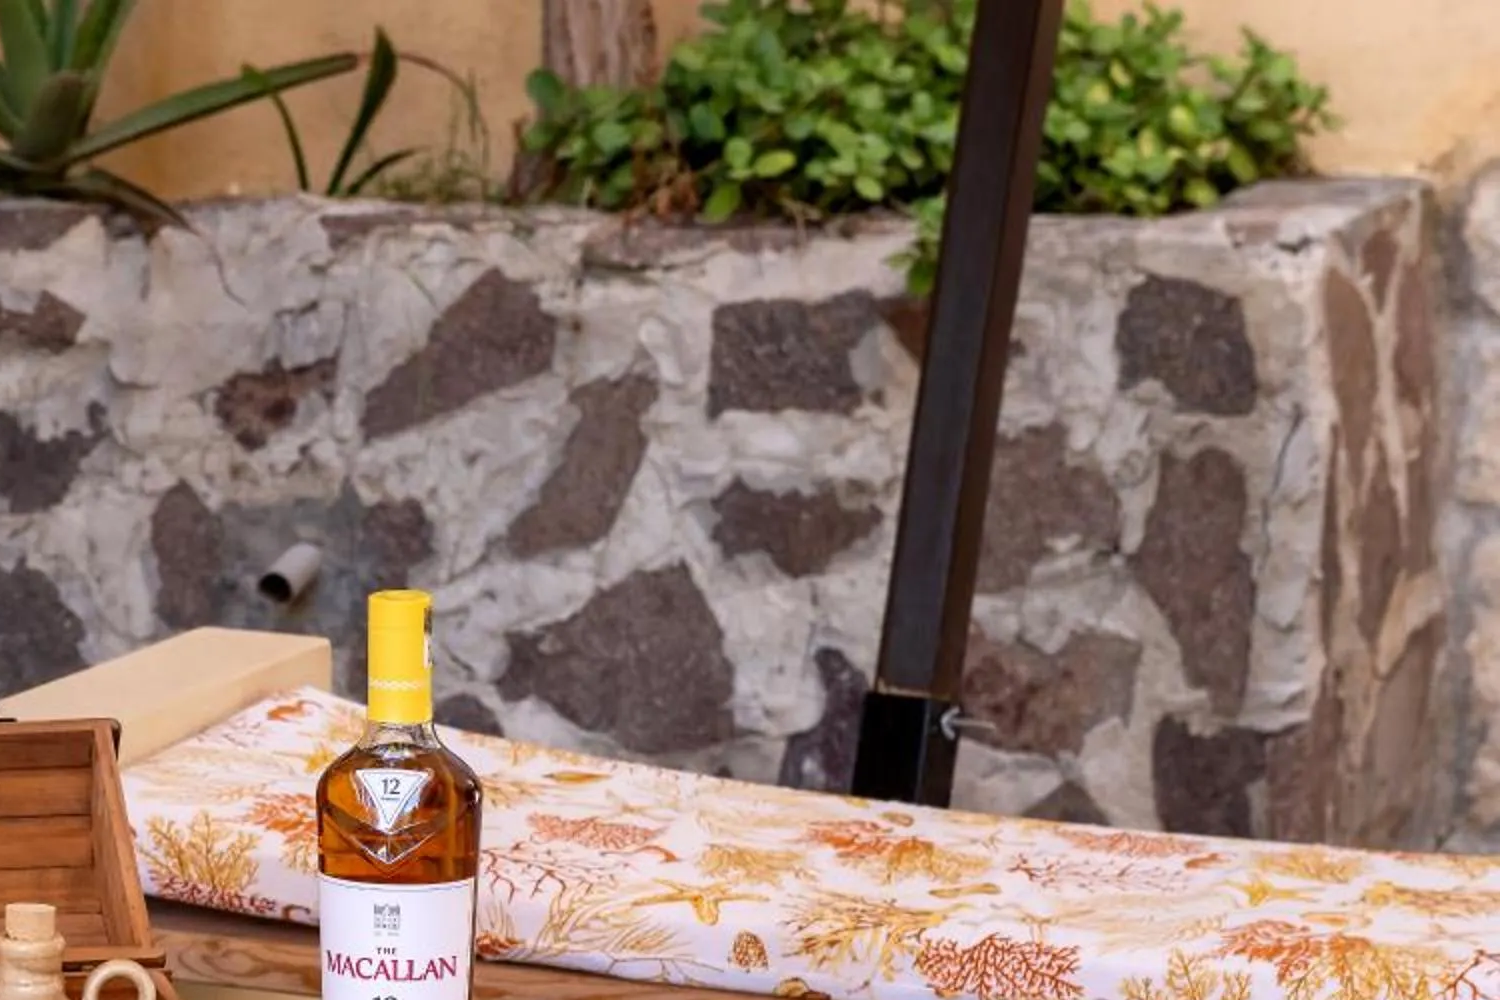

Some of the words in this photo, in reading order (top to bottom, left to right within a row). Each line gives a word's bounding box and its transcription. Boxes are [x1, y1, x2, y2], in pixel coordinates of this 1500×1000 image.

[381, 778, 401, 795] 12
[375, 947, 397, 955] THE
[325, 949, 458, 981] MACALLAN
